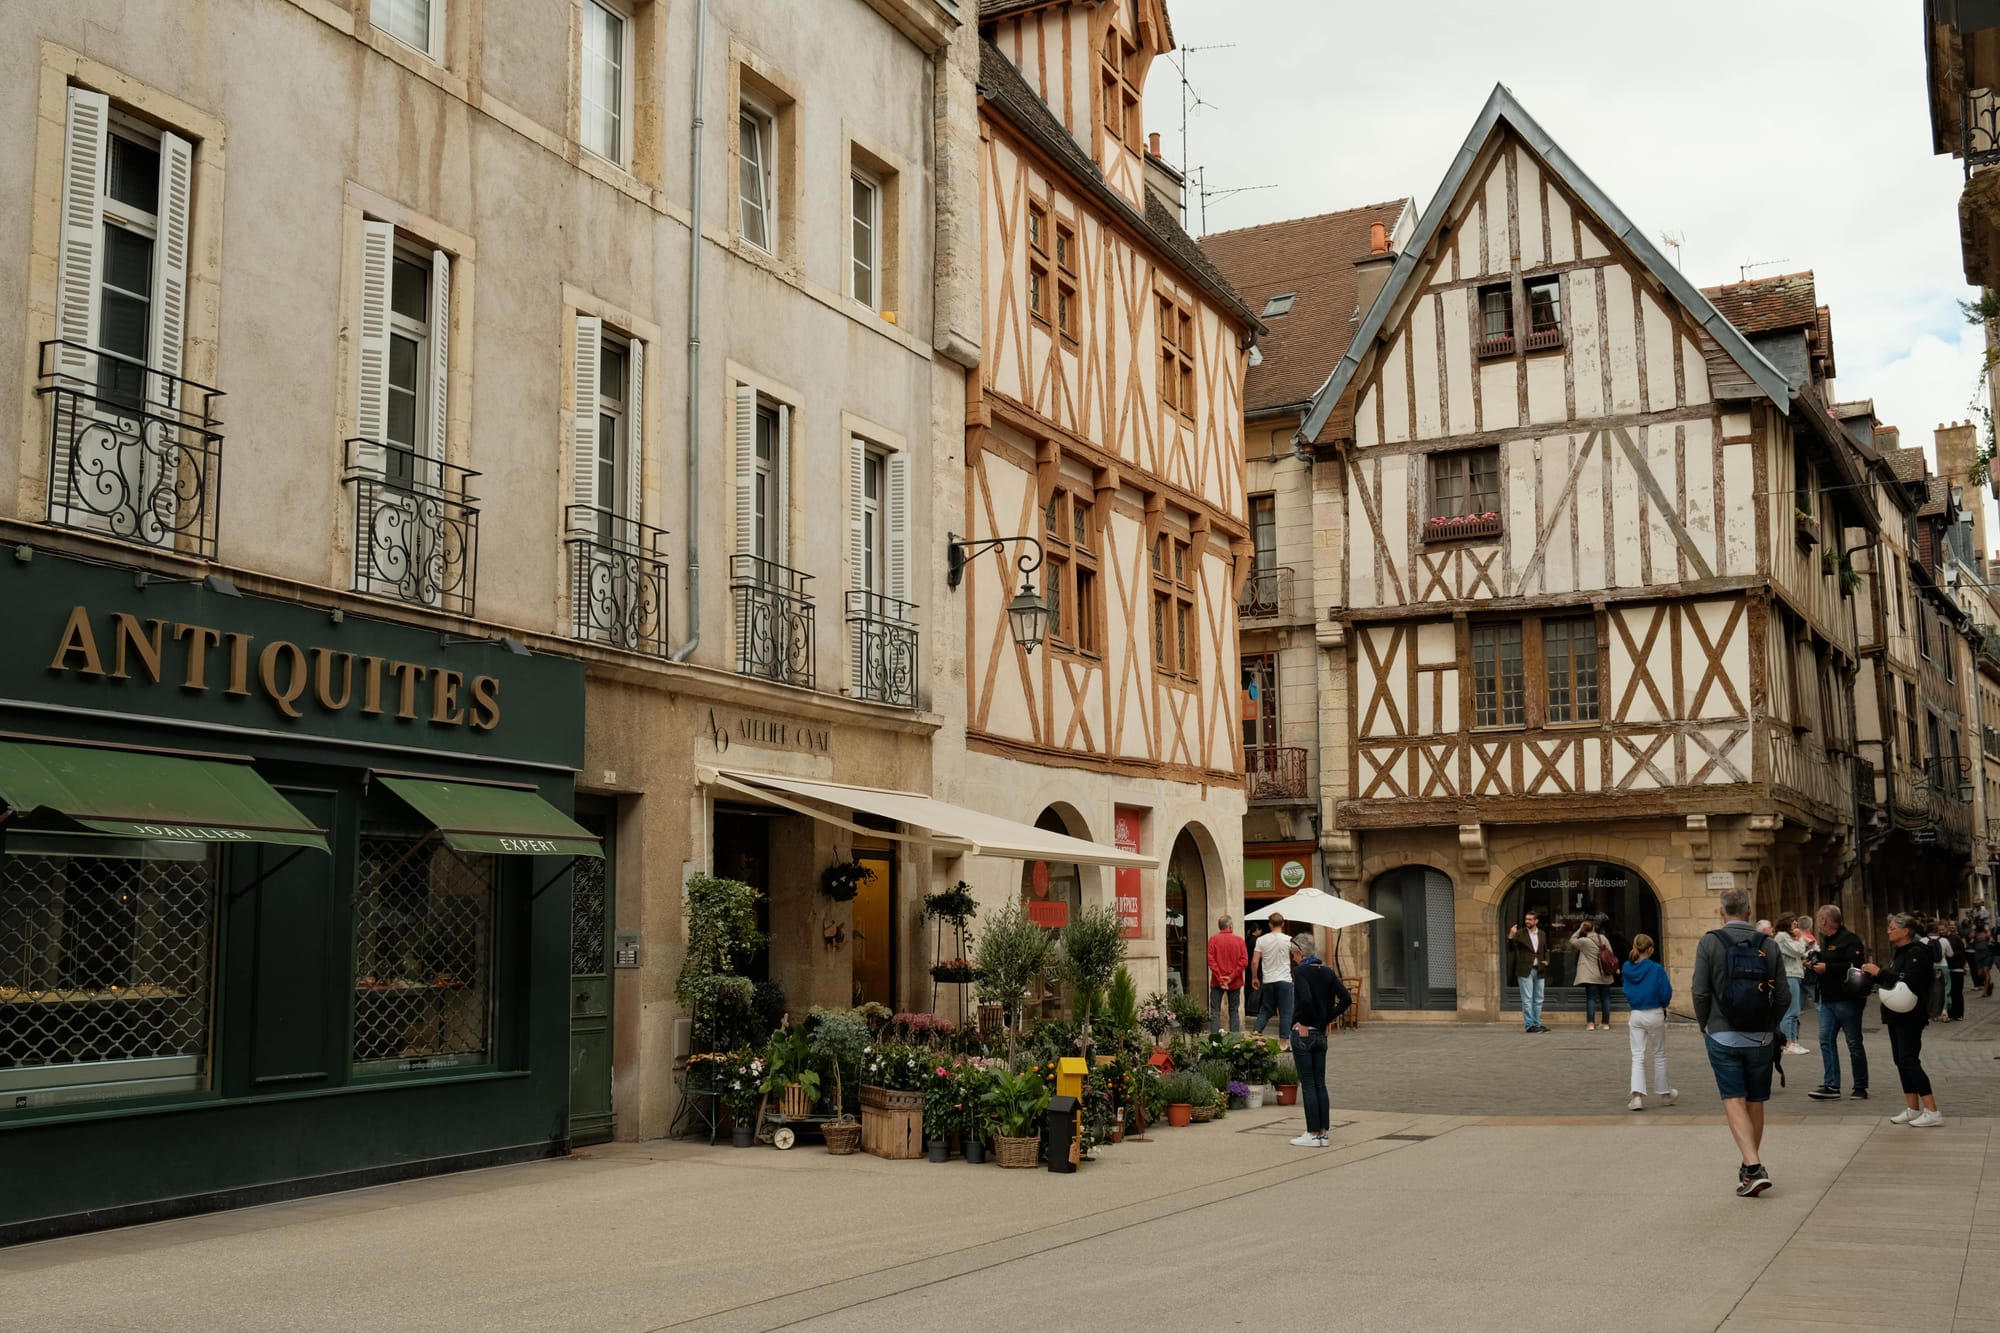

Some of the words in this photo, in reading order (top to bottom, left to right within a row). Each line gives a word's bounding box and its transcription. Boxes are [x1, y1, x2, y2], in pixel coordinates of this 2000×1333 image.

[49, 605, 500, 730] ANTIQUITES
[133, 825, 252, 840] JOAILLIER
[499, 838, 558, 852] EXPERT
[1530, 879, 1580, 889] Chocolatier
[1588, 877, 1628, 888] Pâtissier
